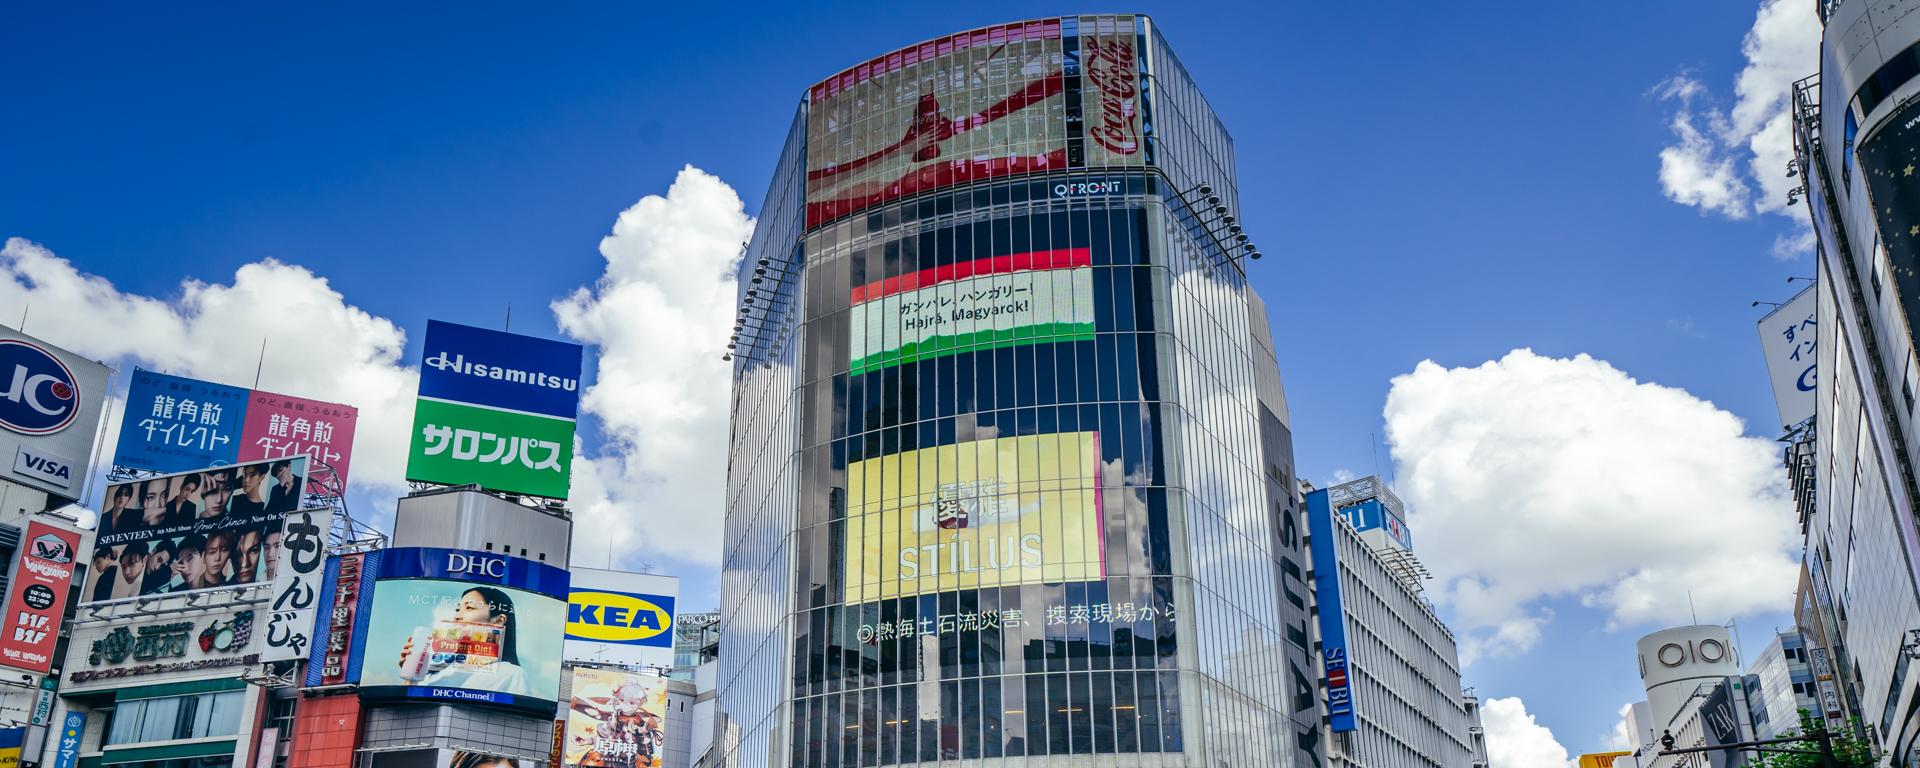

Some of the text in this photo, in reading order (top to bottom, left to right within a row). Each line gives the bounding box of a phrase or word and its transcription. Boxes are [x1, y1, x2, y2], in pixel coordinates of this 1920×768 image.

[1054, 181, 1121, 198] QFRONT
[425, 351, 577, 391] Hisamitsu
[151, 394, 223, 426] 龍角散
[138, 418, 230, 451] ダイレクト
[268, 413, 334, 445] 龍角散
[422, 423, 562, 473] サロンパス
[22, 451, 70, 480] VISA
[100, 529, 154, 546] SEVENTEEN
[446, 554, 506, 578] DHC
[898, 533, 1044, 582] STÍLUS
[266, 512, 324, 657] もんじゃ
[19, 611, 49, 628] B1F
[678, 613, 708, 625] PARCO
[14, 628, 47, 644] B2F
[432, 688, 490, 701] DHC Channel
[1325, 647, 1350, 715] SEIBU
